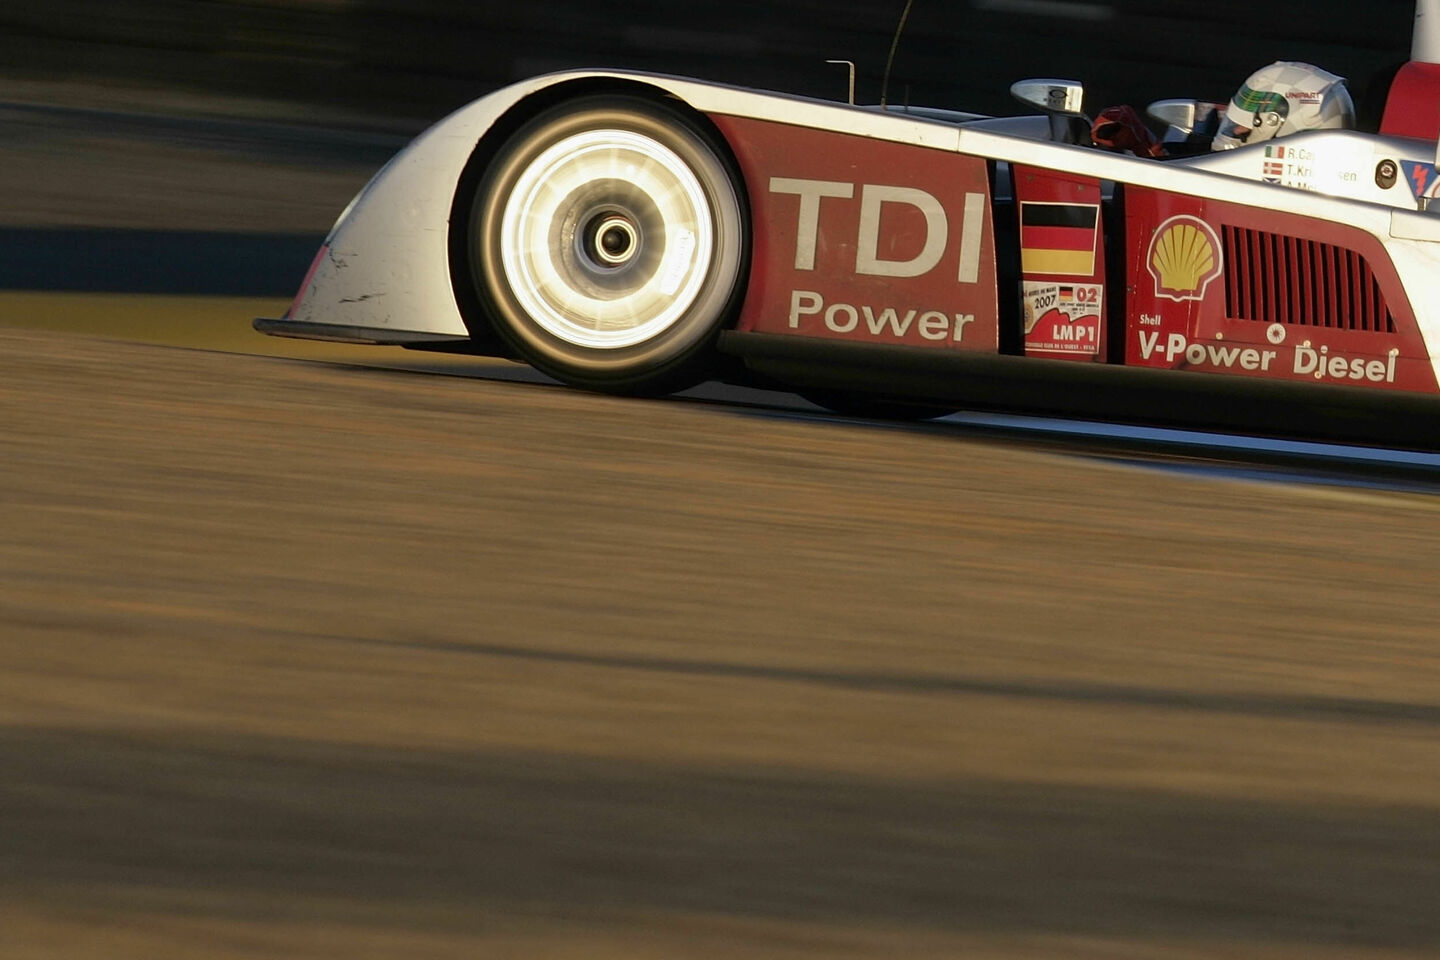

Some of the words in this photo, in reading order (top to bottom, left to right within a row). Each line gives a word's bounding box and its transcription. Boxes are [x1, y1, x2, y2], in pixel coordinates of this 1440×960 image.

[769, 177, 985, 284] TDI
[1034, 294, 1056, 309] 2007
[1077, 288, 1097, 302] 02
[788, 290, 975, 342] Power
[1139, 314, 1161, 326] Shell
[1138, 330, 1276, 371] V-Power
[1293, 343, 1396, 383] Diesel
